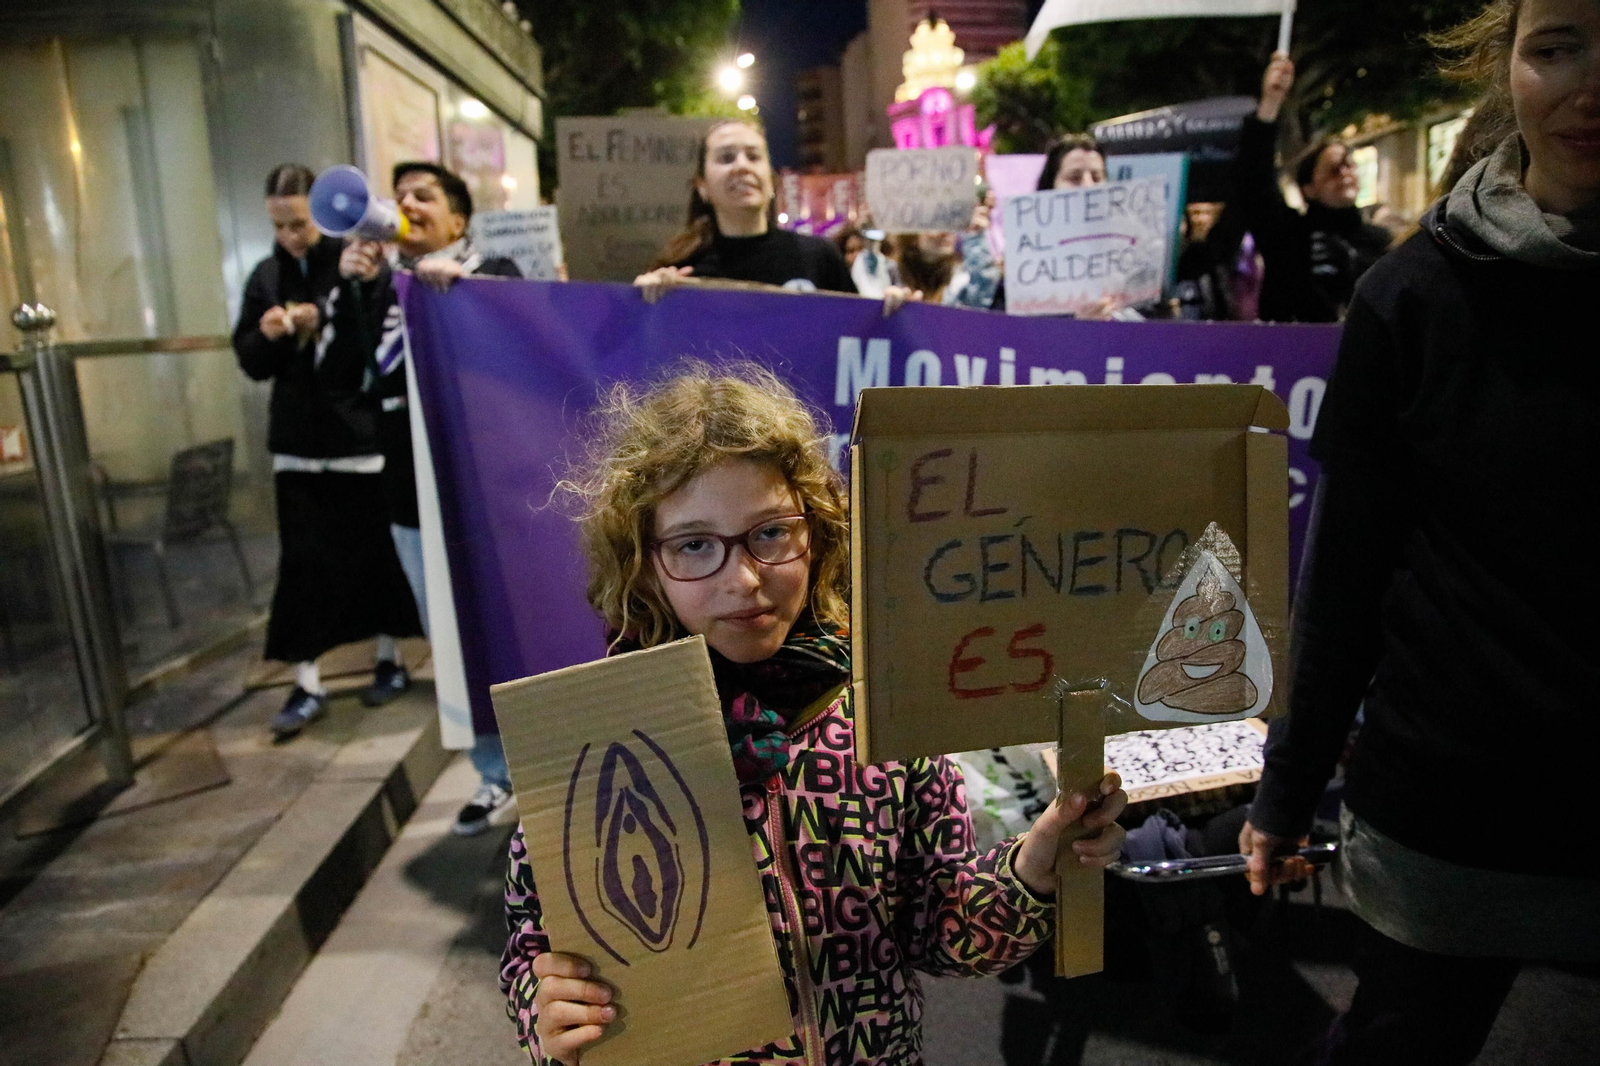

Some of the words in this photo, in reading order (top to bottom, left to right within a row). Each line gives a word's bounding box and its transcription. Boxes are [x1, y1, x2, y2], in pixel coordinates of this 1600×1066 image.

[569, 131, 599, 161] EL
[880, 154, 967, 184] PORNO
[1016, 232, 1054, 254] AL
[1017, 248, 1137, 286] CALDERO
[906, 447, 1008, 524] EL
[948, 623, 1054, 700] ES
